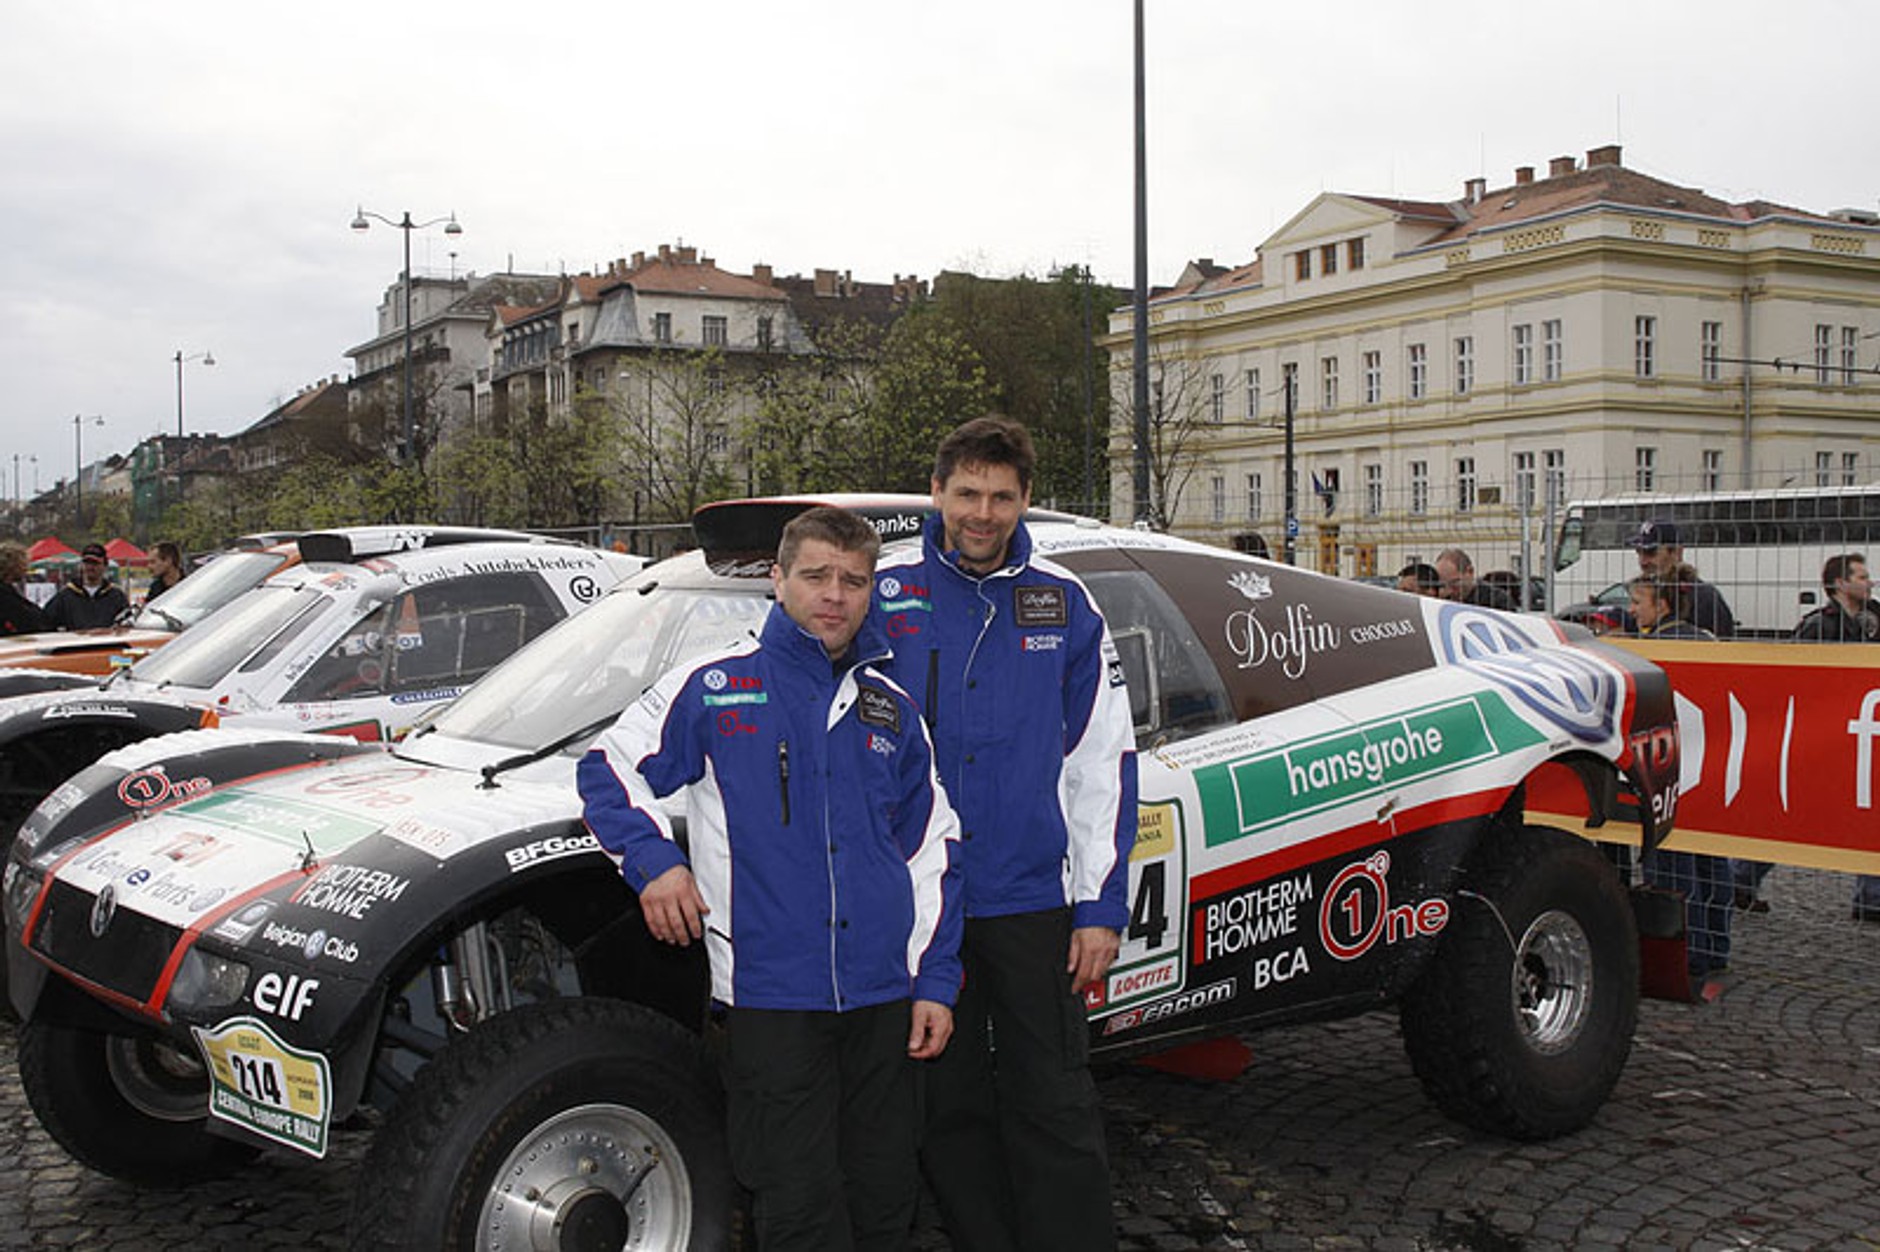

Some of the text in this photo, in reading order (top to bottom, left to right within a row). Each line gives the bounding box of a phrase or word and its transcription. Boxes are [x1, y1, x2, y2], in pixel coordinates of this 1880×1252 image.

[1226, 603, 1341, 680] Dolfin
[1285, 716, 1444, 797] hansgrohe
[296, 883, 377, 920] HOMME
[317, 864, 410, 902] BIOTHERM
[1207, 872, 1313, 932] BIOTHERM
[324, 936, 359, 962] Club
[1207, 906, 1297, 960] HOMME
[1114, 964, 1173, 997] LOCTITE
[1255, 946, 1310, 990] BCA
[254, 972, 320, 1021] elf
[231, 1054, 282, 1105] 214
